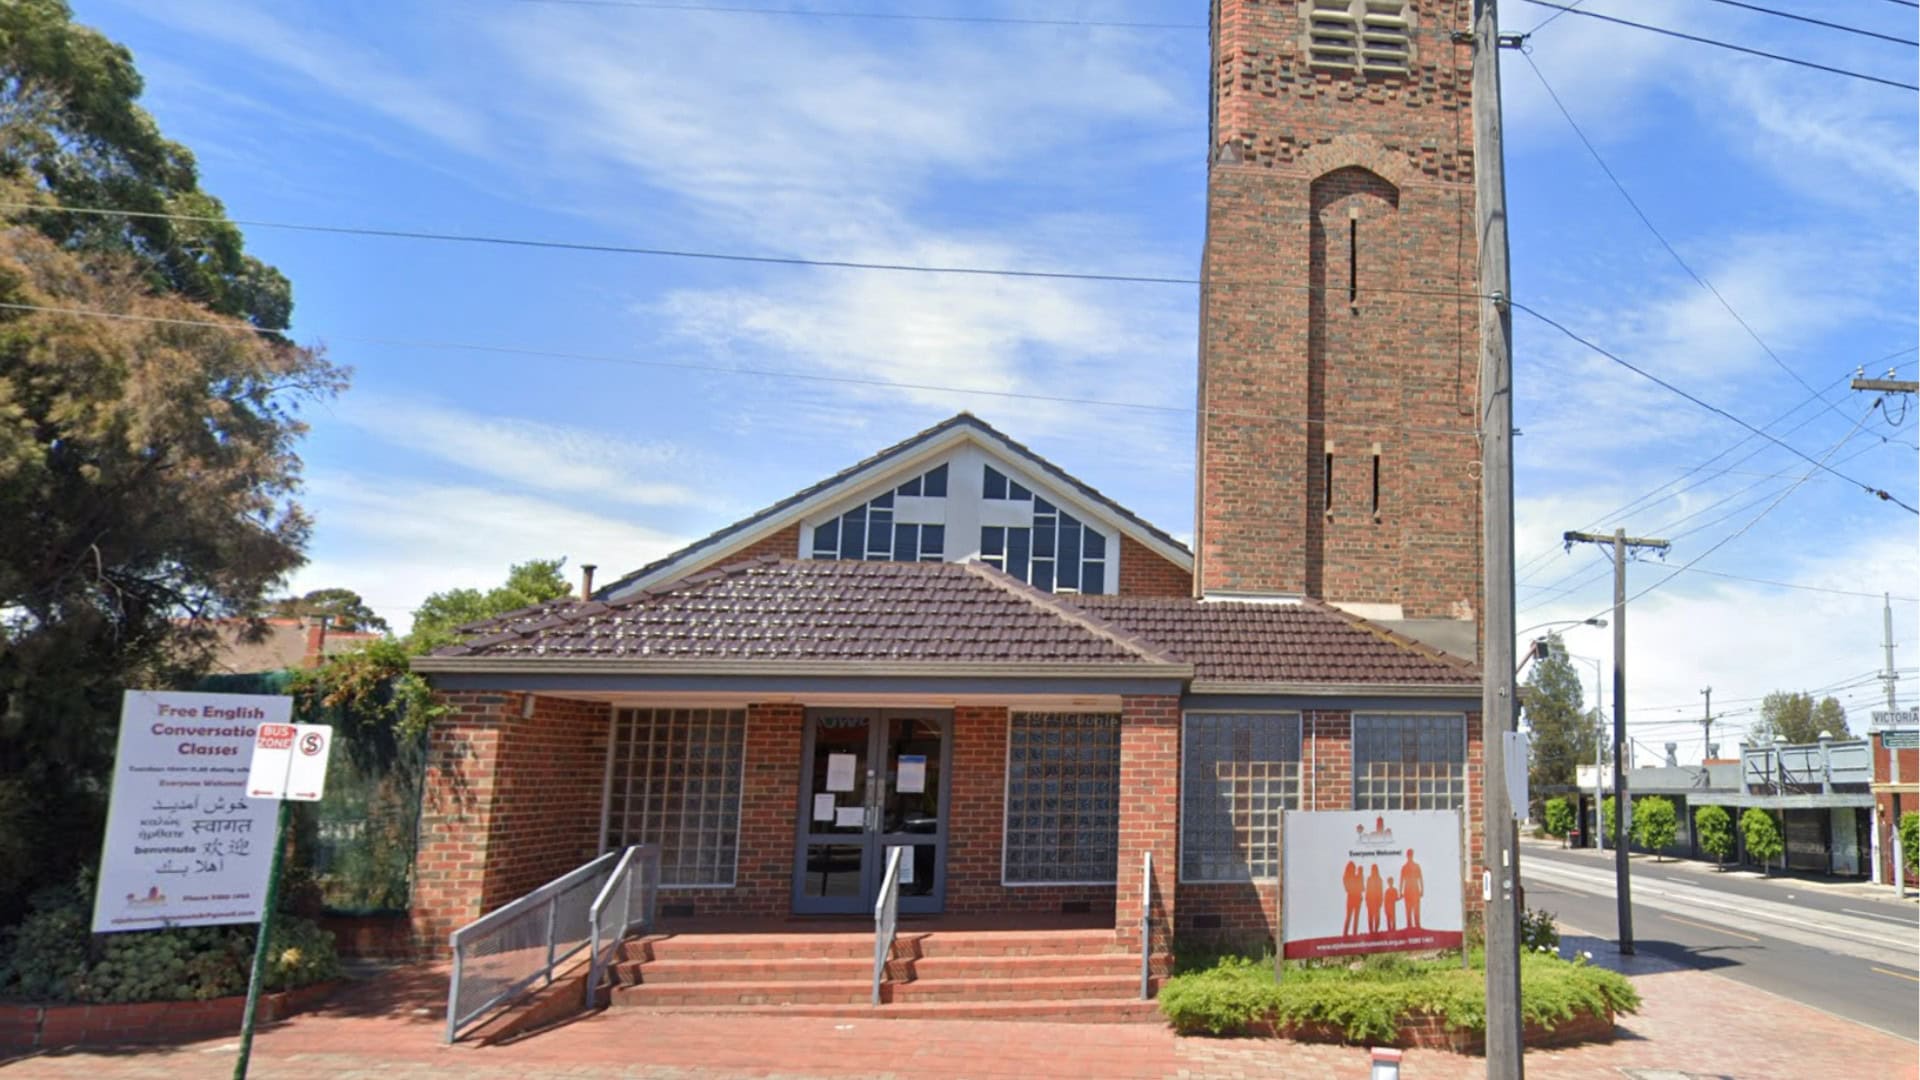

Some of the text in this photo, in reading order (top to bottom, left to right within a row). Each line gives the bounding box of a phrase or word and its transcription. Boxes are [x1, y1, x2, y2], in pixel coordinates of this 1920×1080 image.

[158, 704, 265, 721] Free English
[1872, 711, 1919, 722] VICTORIA
[151, 723, 256, 738] Conversatio
[263, 725, 289, 738] BUS
[178, 742, 239, 756] Classes
[258, 737, 292, 749] ZONE
[192, 819, 254, 834] स्वागत
